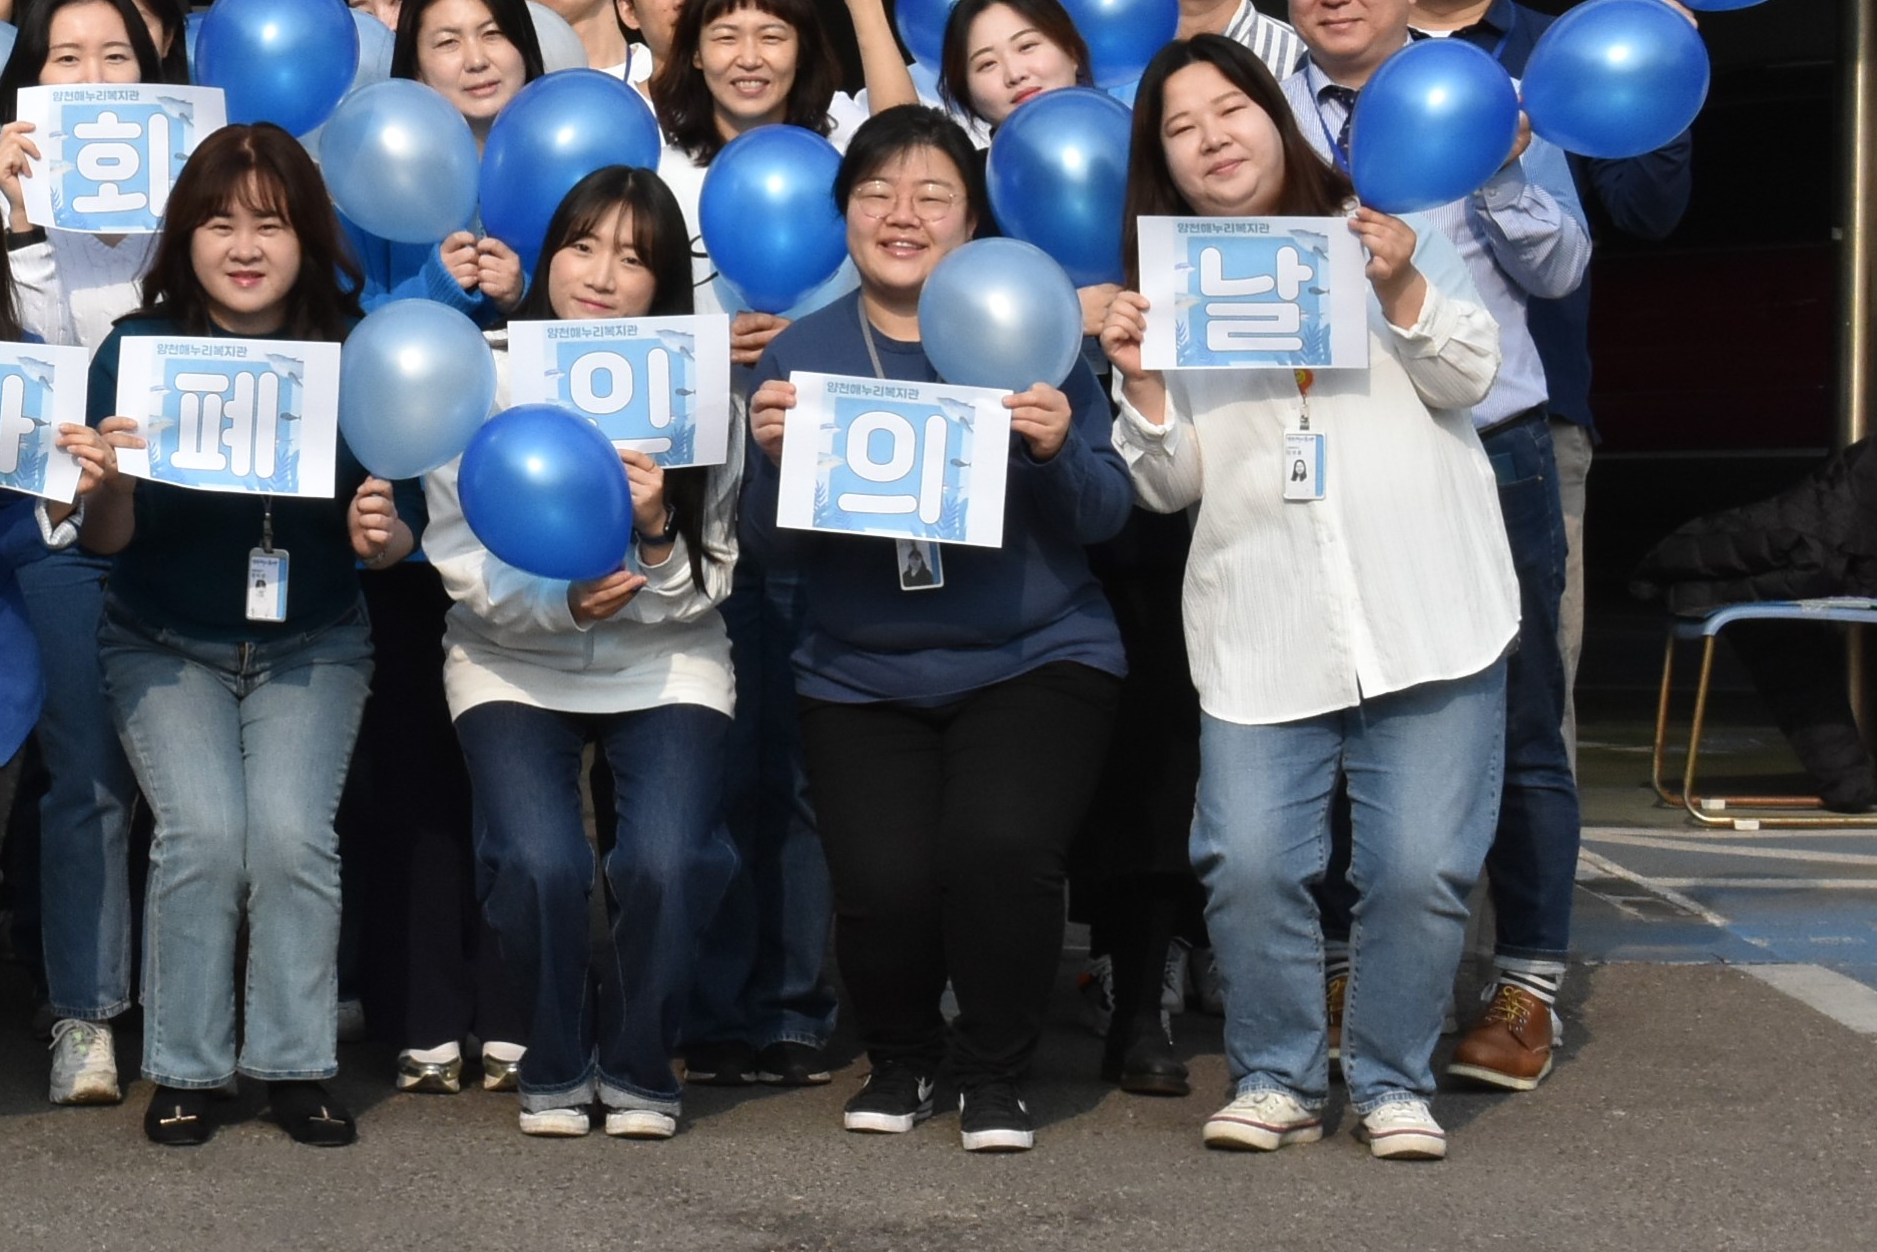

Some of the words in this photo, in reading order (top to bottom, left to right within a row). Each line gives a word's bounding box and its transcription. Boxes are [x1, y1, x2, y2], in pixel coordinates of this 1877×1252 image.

[52, 89, 140, 102] 양천해누리복지관
[72, 110, 171, 219] 회
[1177, 222, 1270, 234] 양천해누리복지관
[1198, 245, 1314, 353] 날
[157, 343, 248, 358] 양천해누리복지관
[546, 324, 638, 339] 양천해누리복지관
[568, 346, 672, 454] 인
[827, 381, 920, 401] 양천해누리복지관
[169, 370, 281, 480] 폐
[837, 409, 949, 526] 의
